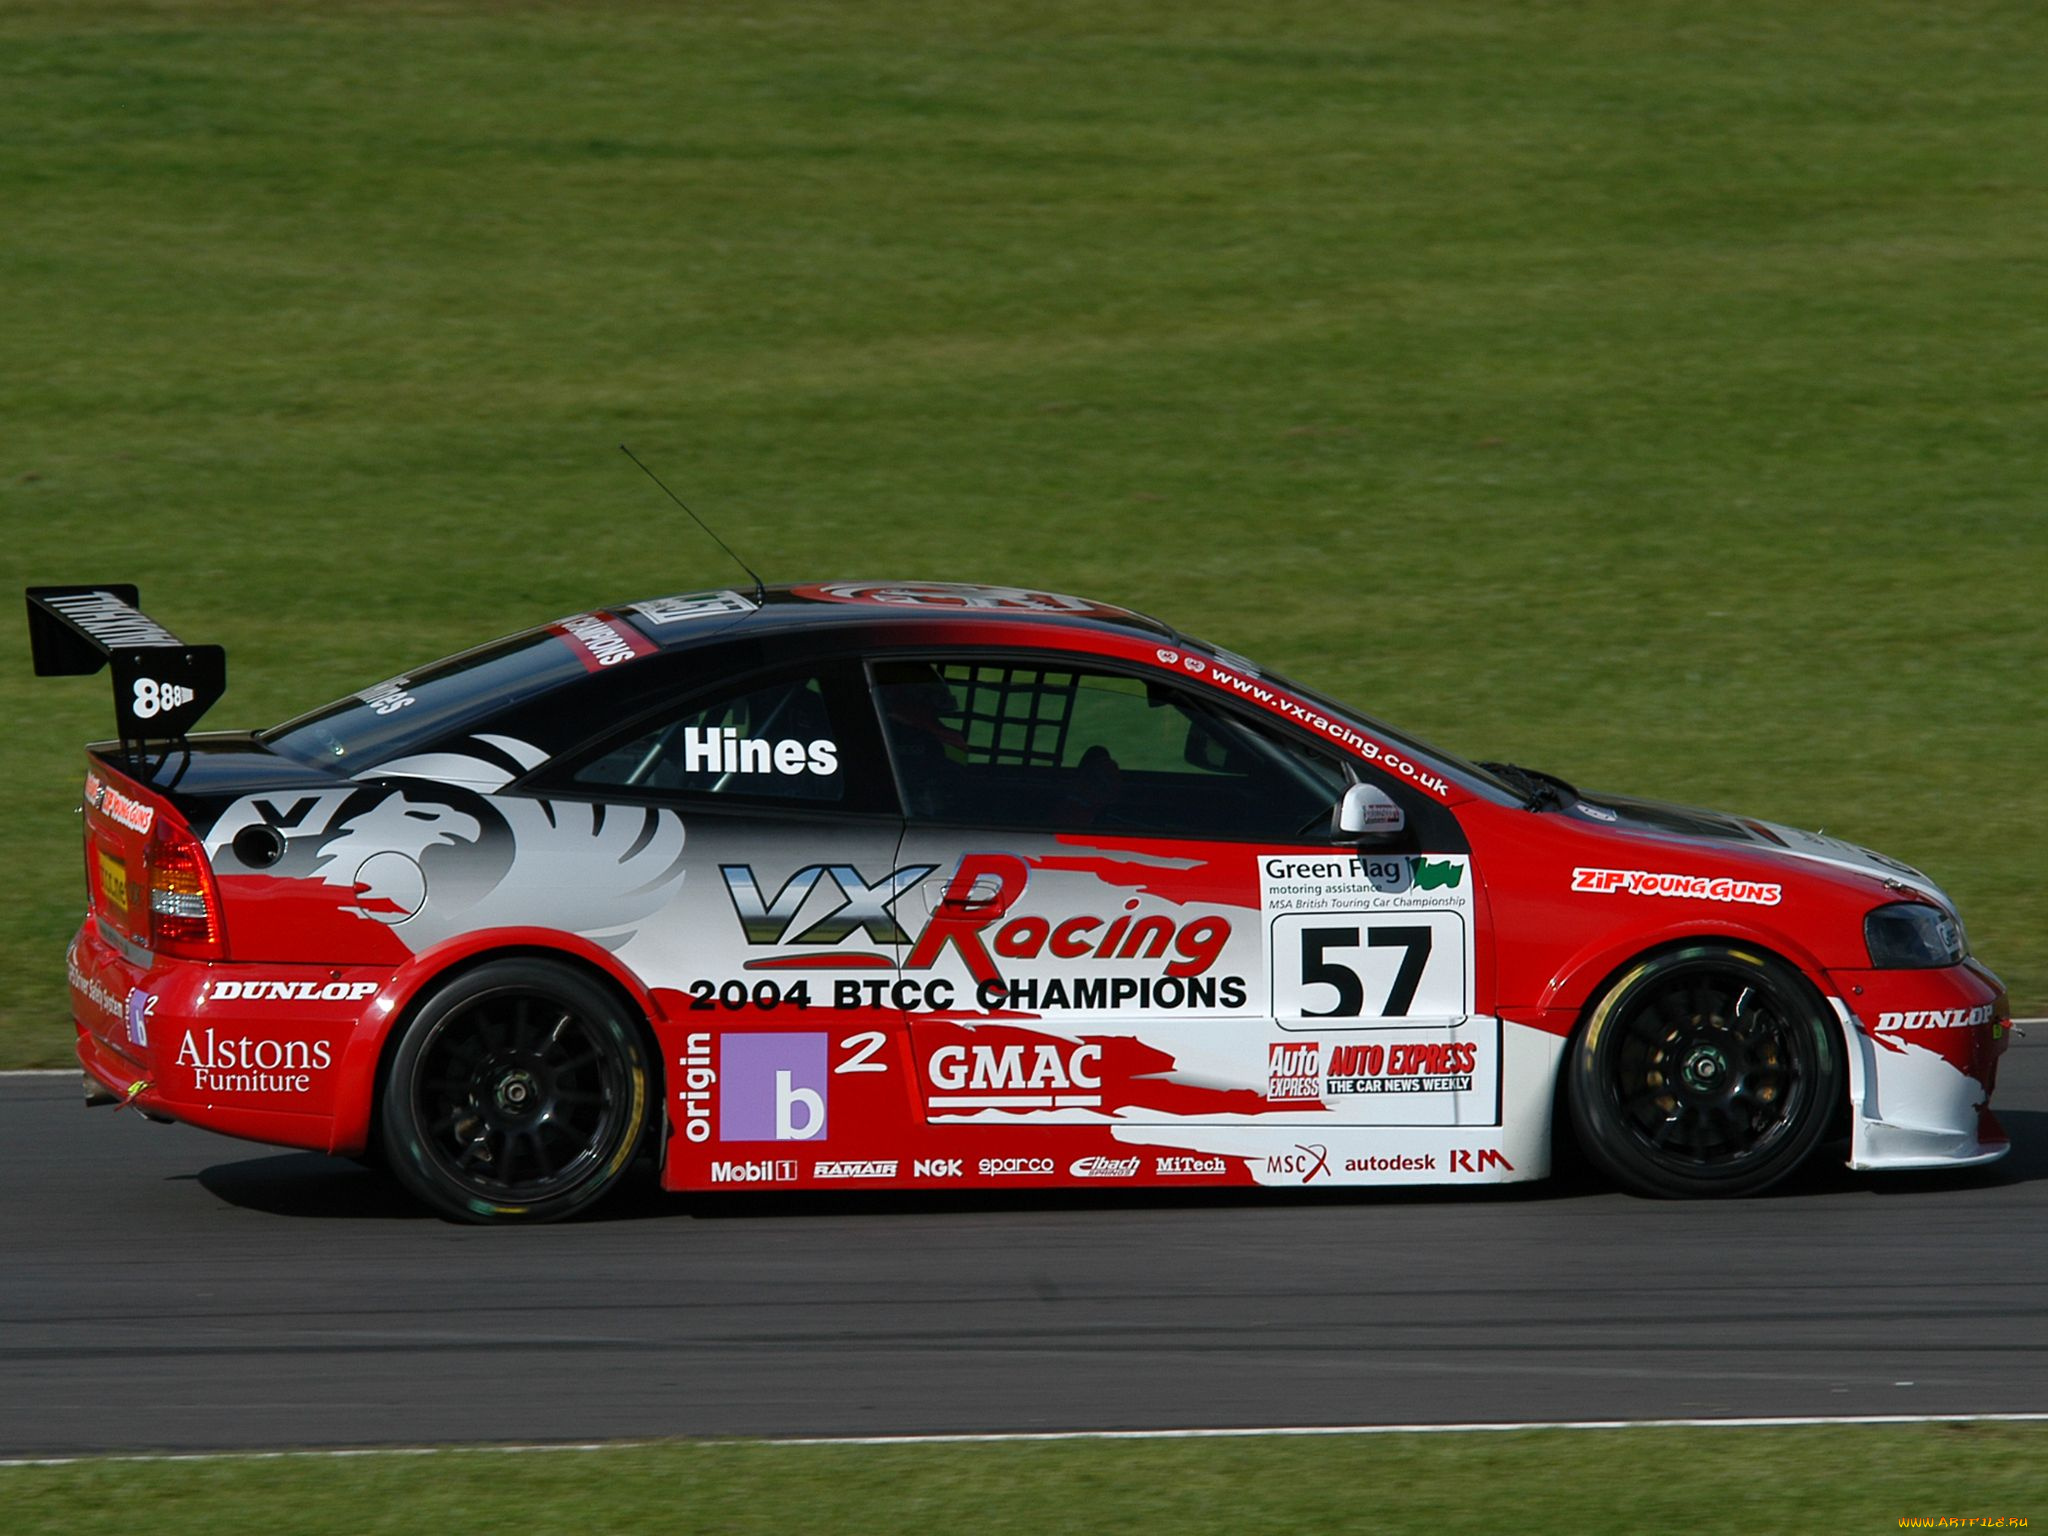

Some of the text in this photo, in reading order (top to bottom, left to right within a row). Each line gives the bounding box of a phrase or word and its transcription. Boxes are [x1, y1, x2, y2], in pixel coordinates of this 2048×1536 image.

[1213, 669, 1448, 796] www.vxracing.co.uk
[685, 727, 838, 775] Hines
[1266, 858, 1400, 883] Green Flag
[1269, 883, 1382, 896] motoring assistance
[1630, 873, 1707, 894] YOUNG
[1709, 880, 1779, 901] GUNS
[1269, 896, 1466, 909] MSA British Touring Car Championship
[1301, 926, 1432, 1017] 57
[210, 981, 378, 1000] DUNLOP
[690, 977, 1247, 1010] 2004 BTCC CHAMPIONS
[1874, 1004, 1993, 1031] DUNLOP
[176, 1028, 331, 1069] Alstons
[1328, 1043, 1477, 1076] AUTO EXPRESS
[929, 1045, 1102, 1090] GMAC
[1271, 1046, 1319, 1077] Auto
[194, 1069, 310, 1092] Furniture
[680, 1033, 716, 1143] origin
[776, 1032, 887, 1140] b 2
[1270, 1078, 1319, 1097] EXPRESS
[1329, 1077, 1470, 1092] THE CAR NEWS WEEKLY
[711, 1161, 772, 1182] Mobil
[814, 1160, 898, 1178] RAMAIR
[914, 1159, 963, 1178] NGK
[979, 1158, 1054, 1176] sparco
[1156, 1157, 1226, 1173] MiTech
[1345, 1154, 1435, 1172] autodesk
[1450, 1149, 1514, 1173] RM
